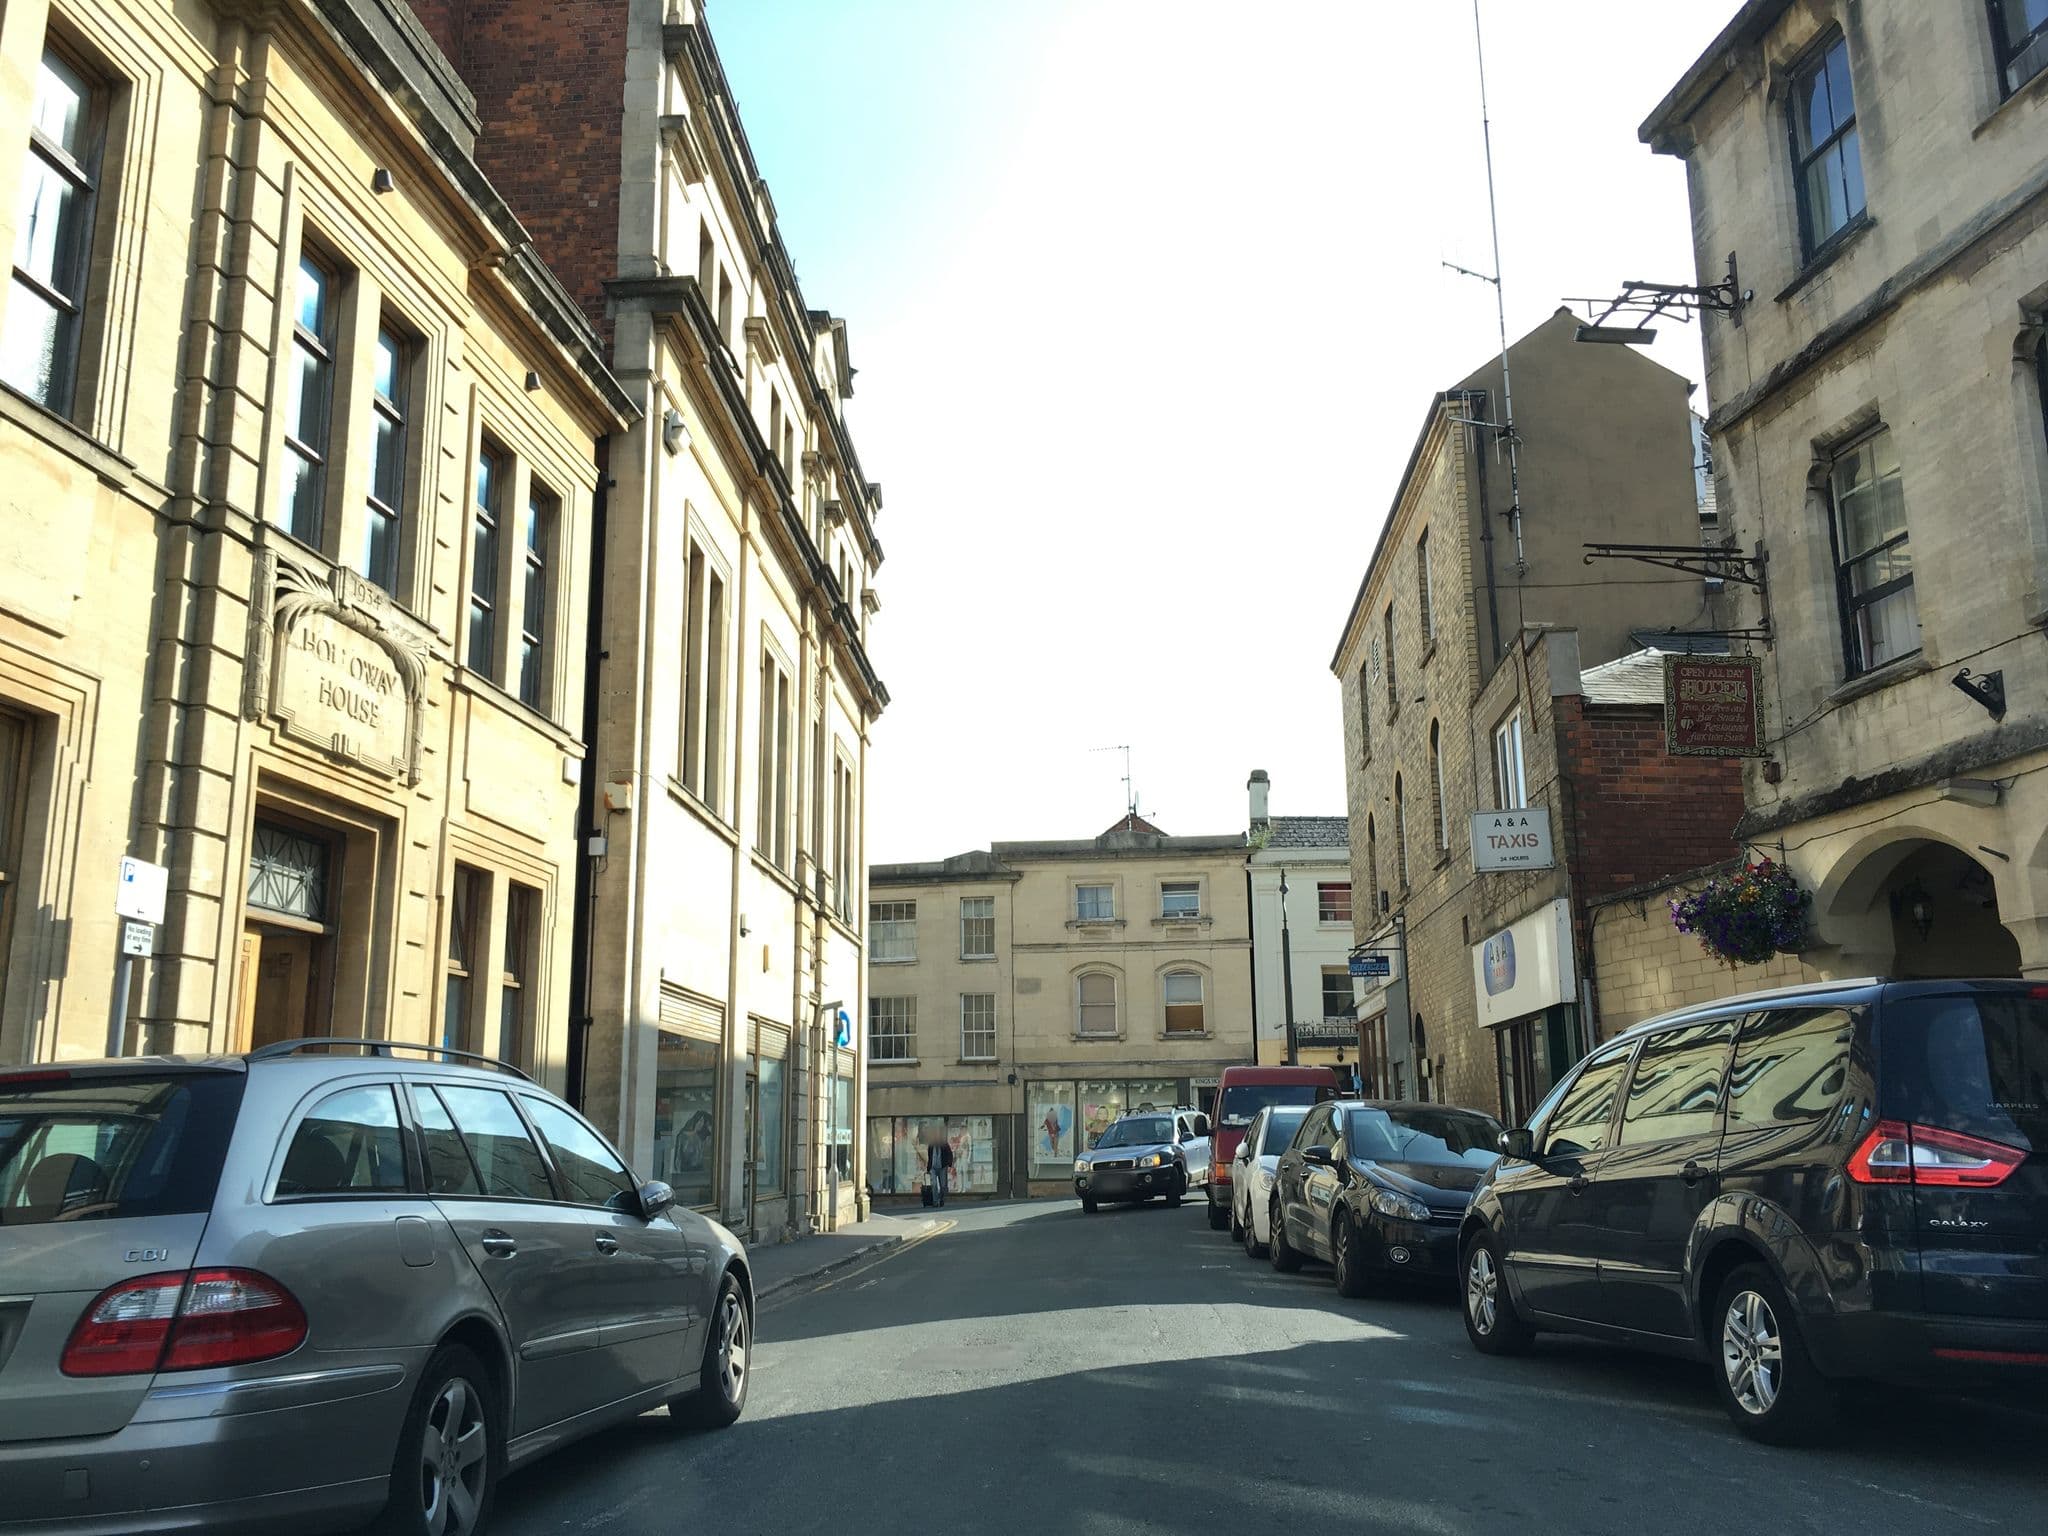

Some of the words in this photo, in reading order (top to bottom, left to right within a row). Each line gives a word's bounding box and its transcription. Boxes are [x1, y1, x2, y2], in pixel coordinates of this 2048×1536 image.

[353, 580, 382, 610] 1934
[1680, 667, 1705, 677] OPEN
[1708, 668, 1725, 678] ALL
[1726, 669, 1745, 678] DAY
[1681, 679, 1747, 698] HOTEL
[319, 676, 380, 728] HOUSE
[1697, 713, 1712, 722] Bar
[1718, 712, 1745, 723] Snacks
[1704, 721, 1749, 732] Restaurant
[1494, 818, 1502, 828] A
[1507, 817, 1515, 827] &
[1520, 817, 1528, 827] A
[1487, 833, 1539, 849] TAXIS
[128, 924, 135, 933] No
[136, 926, 152, 937] loading
[133, 935, 141, 943] any
[142, 935, 151, 943] time
[1929, 1218, 1988, 1227] GALAXY
[124, 1249, 168, 1262] CDI
